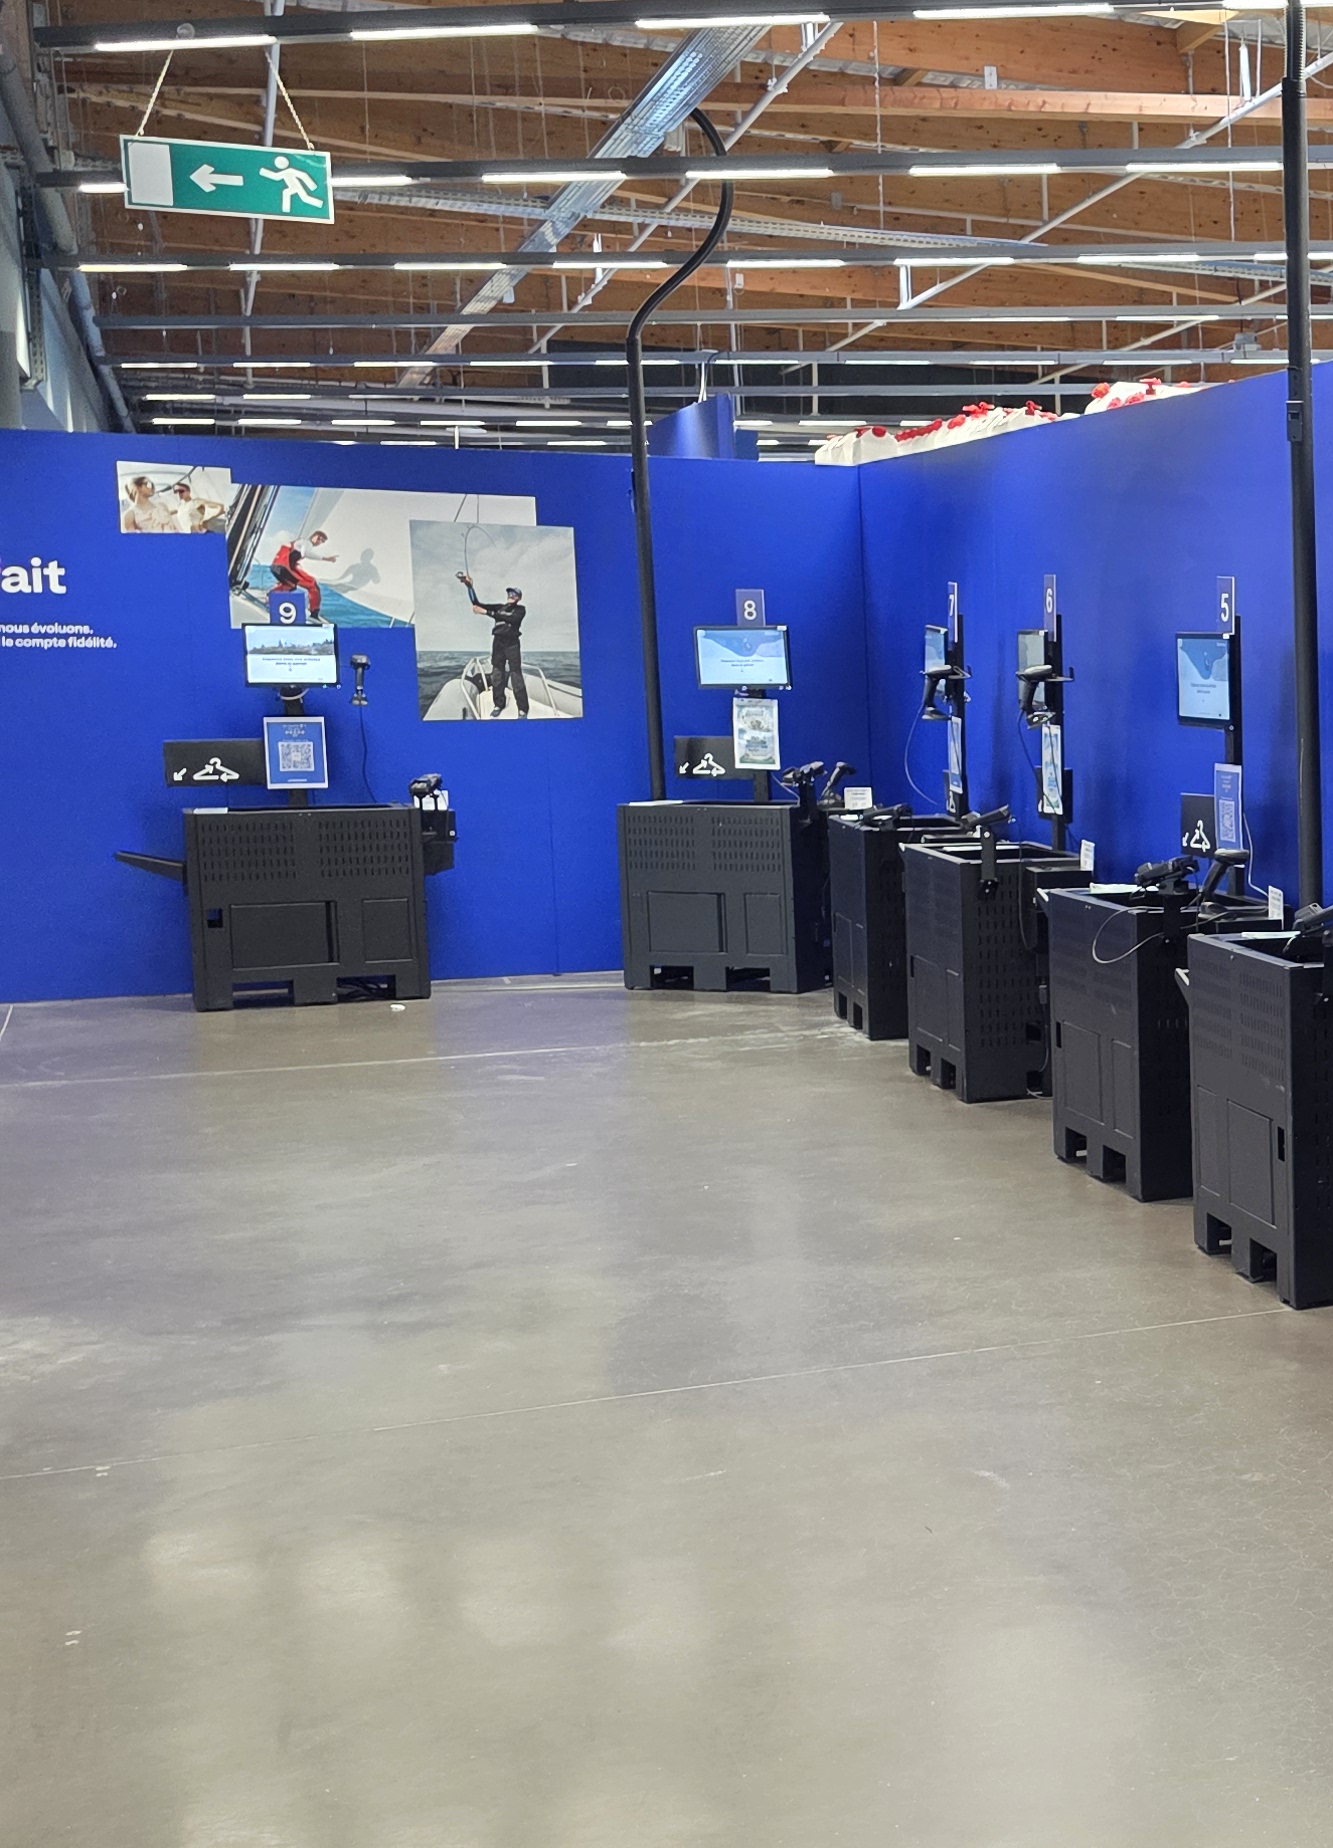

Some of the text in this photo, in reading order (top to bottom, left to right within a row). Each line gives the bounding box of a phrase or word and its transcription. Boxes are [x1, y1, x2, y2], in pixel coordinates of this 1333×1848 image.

[0, 556, 67, 594] ait
[743, 600, 757, 620] 8
[1046, 588, 1053, 613] 6
[1221, 593, 1229, 622] 5
[279, 602, 297, 624] 9
[2, 636, 14, 647] le
[15, 637, 66, 650] compte
